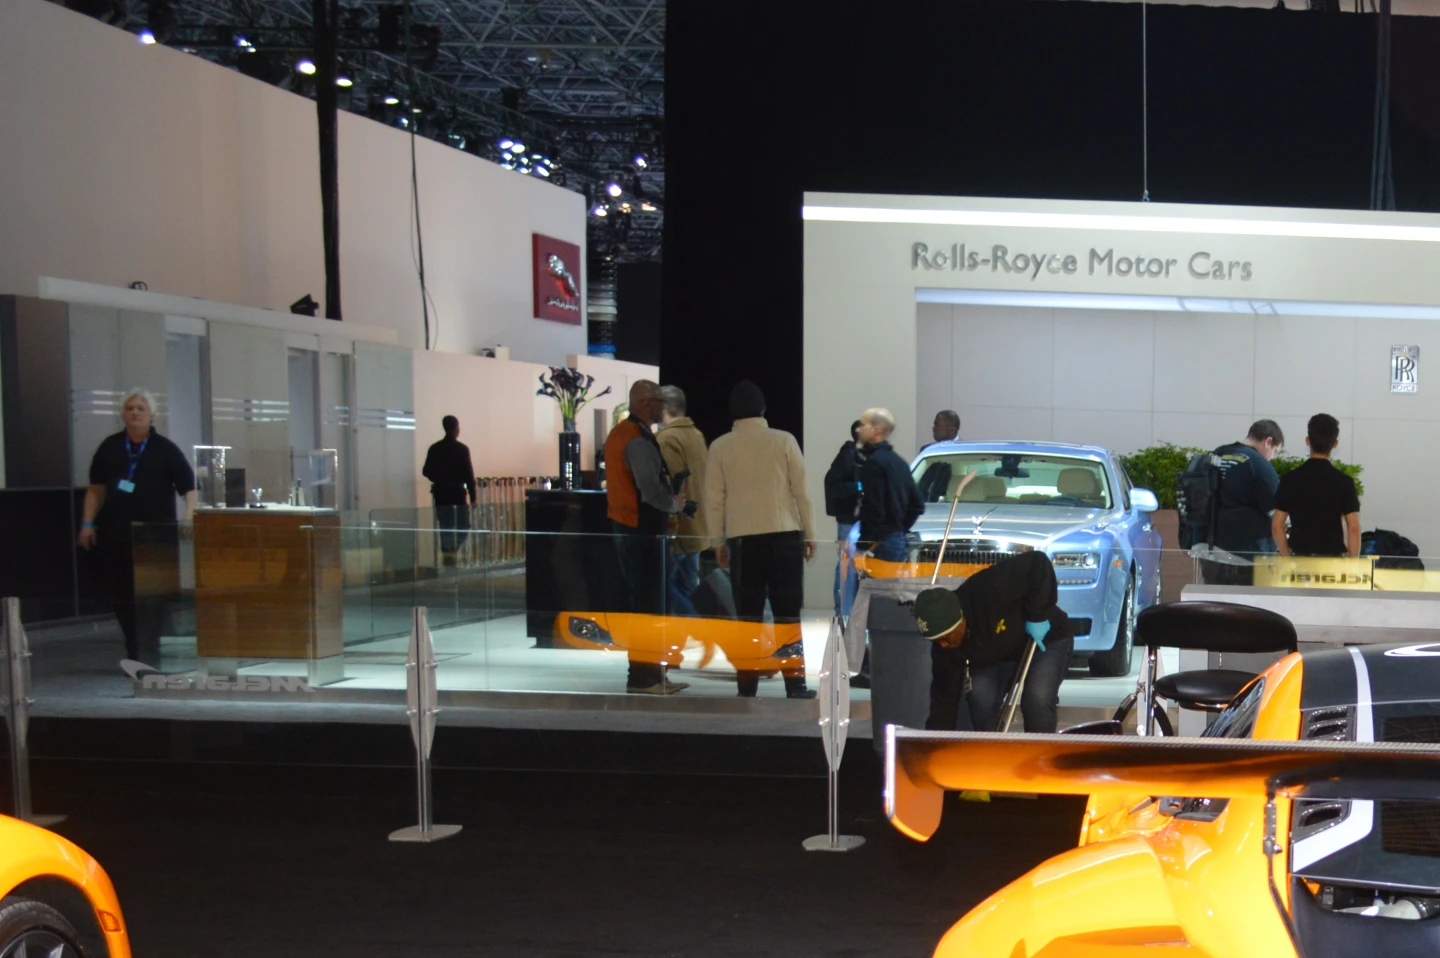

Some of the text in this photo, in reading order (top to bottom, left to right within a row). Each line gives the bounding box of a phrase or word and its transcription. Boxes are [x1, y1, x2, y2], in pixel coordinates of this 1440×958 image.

[911, 242, 1253, 281] Rolls-Royce Motor Cars
